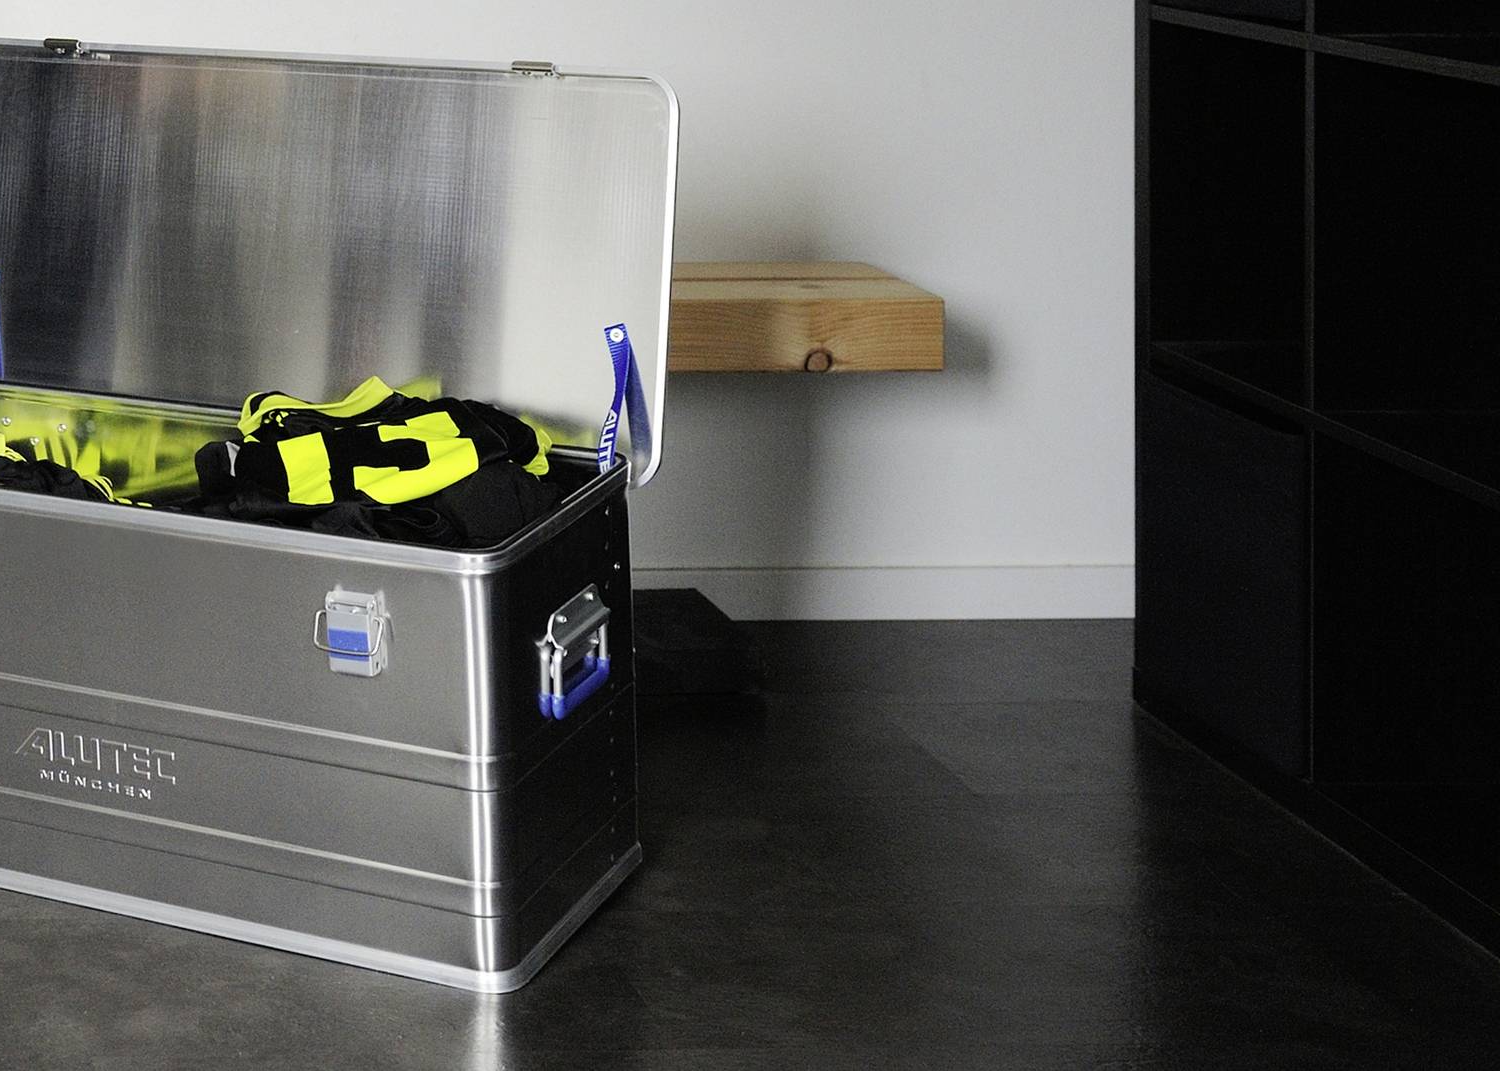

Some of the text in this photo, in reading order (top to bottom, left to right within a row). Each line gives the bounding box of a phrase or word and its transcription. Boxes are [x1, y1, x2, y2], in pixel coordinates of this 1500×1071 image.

[598, 408, 618, 475] ALUTE
[14, 727, 178, 786] ALUTEC
[39, 769, 152, 800] MÜNCHEN
